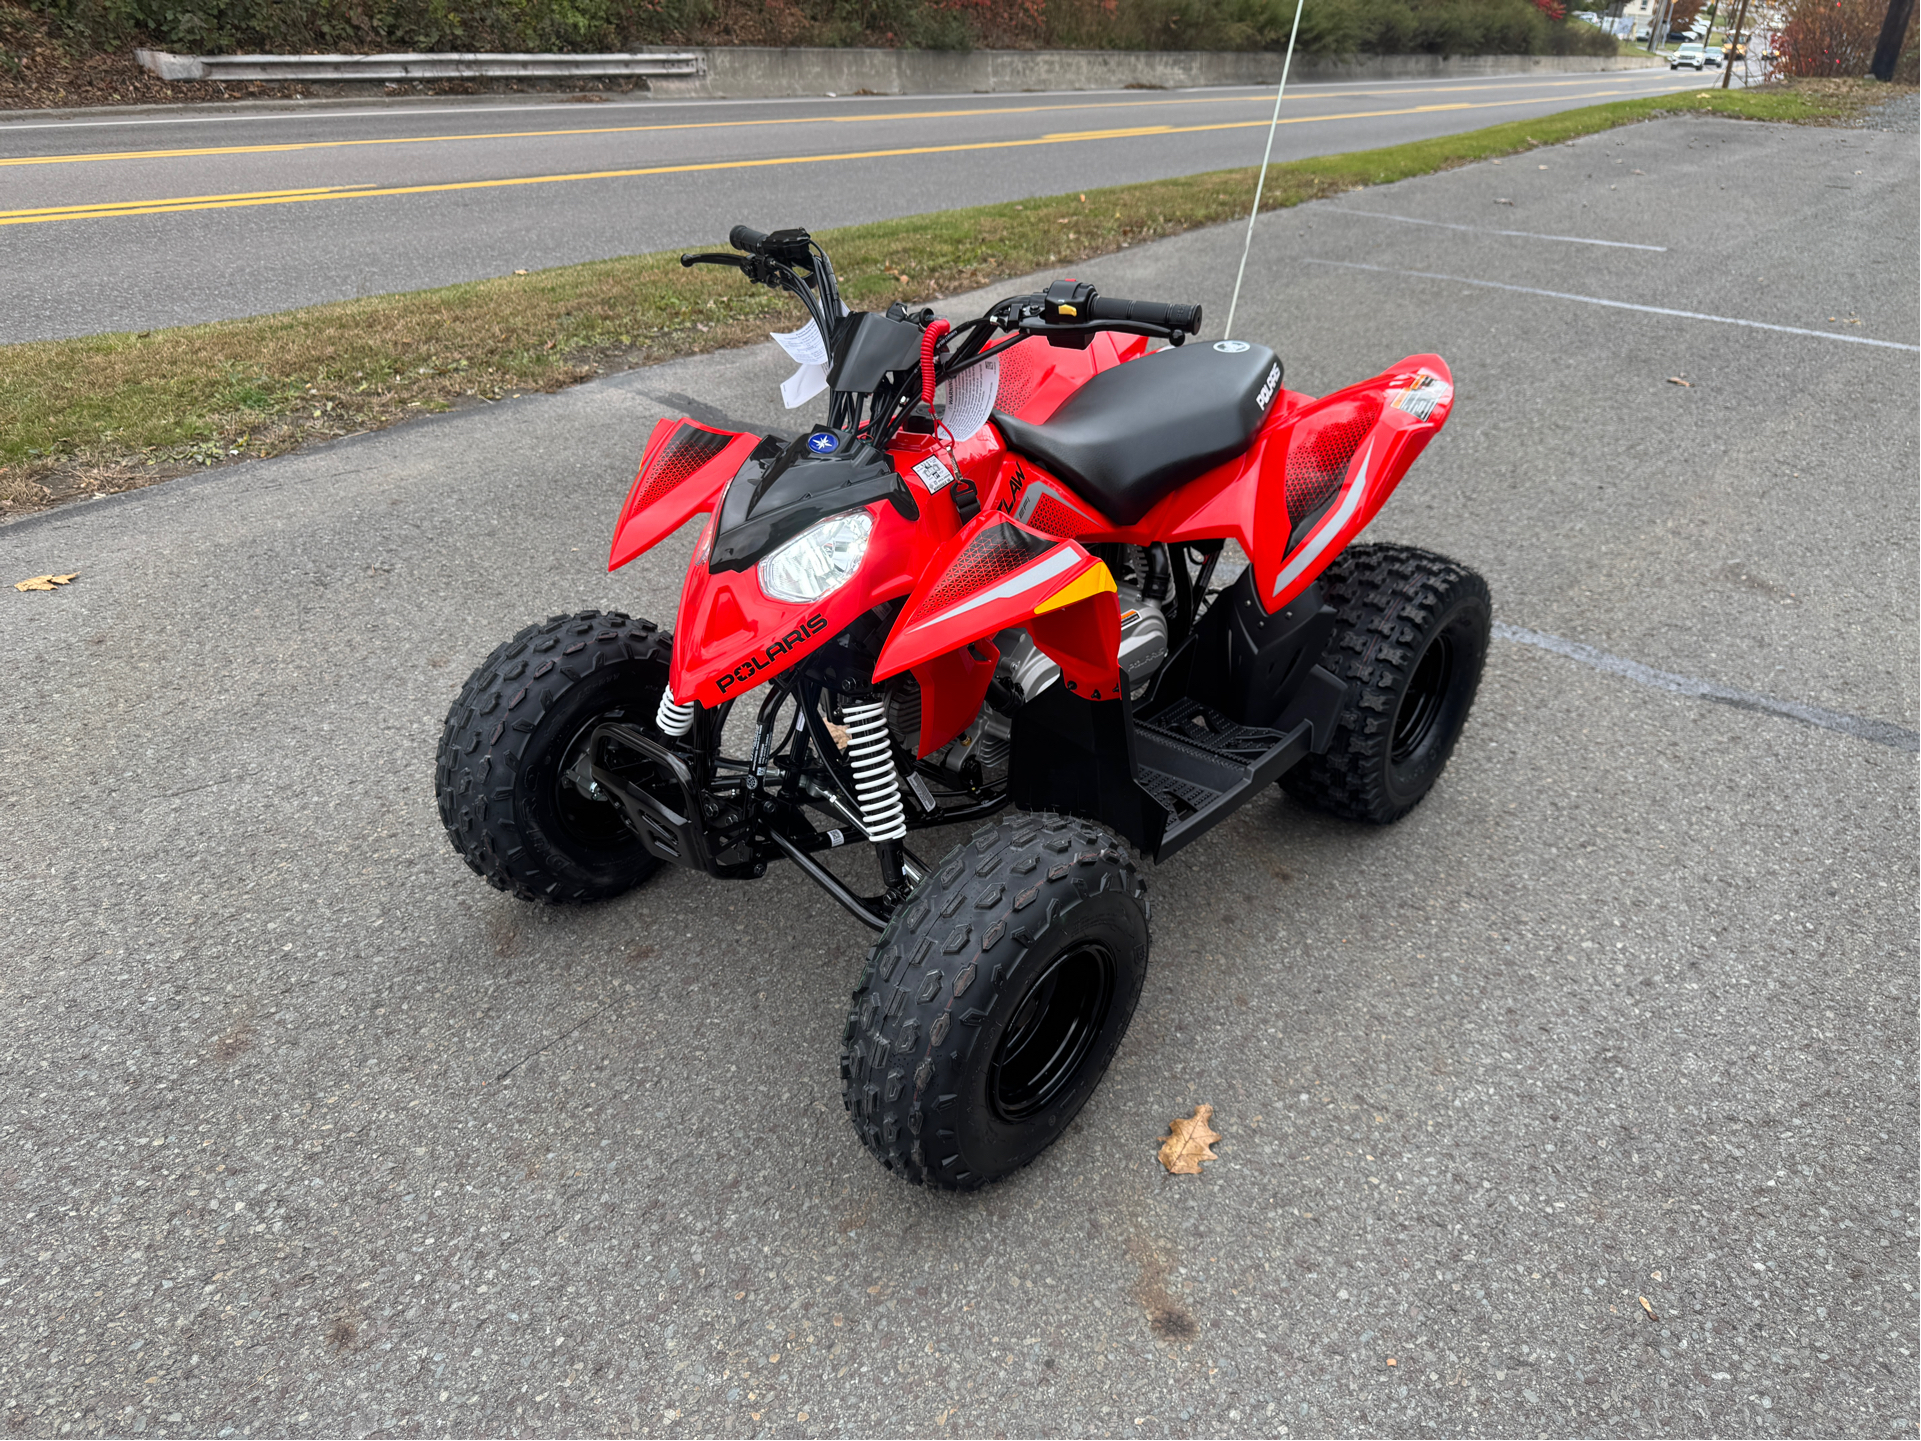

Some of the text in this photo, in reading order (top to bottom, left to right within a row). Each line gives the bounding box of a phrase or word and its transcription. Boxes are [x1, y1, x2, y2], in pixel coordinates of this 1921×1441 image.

[1255, 361, 1281, 411] POLARIS
[1018, 496, 1031, 519] EFI
[715, 613, 828, 694] POLARIS
